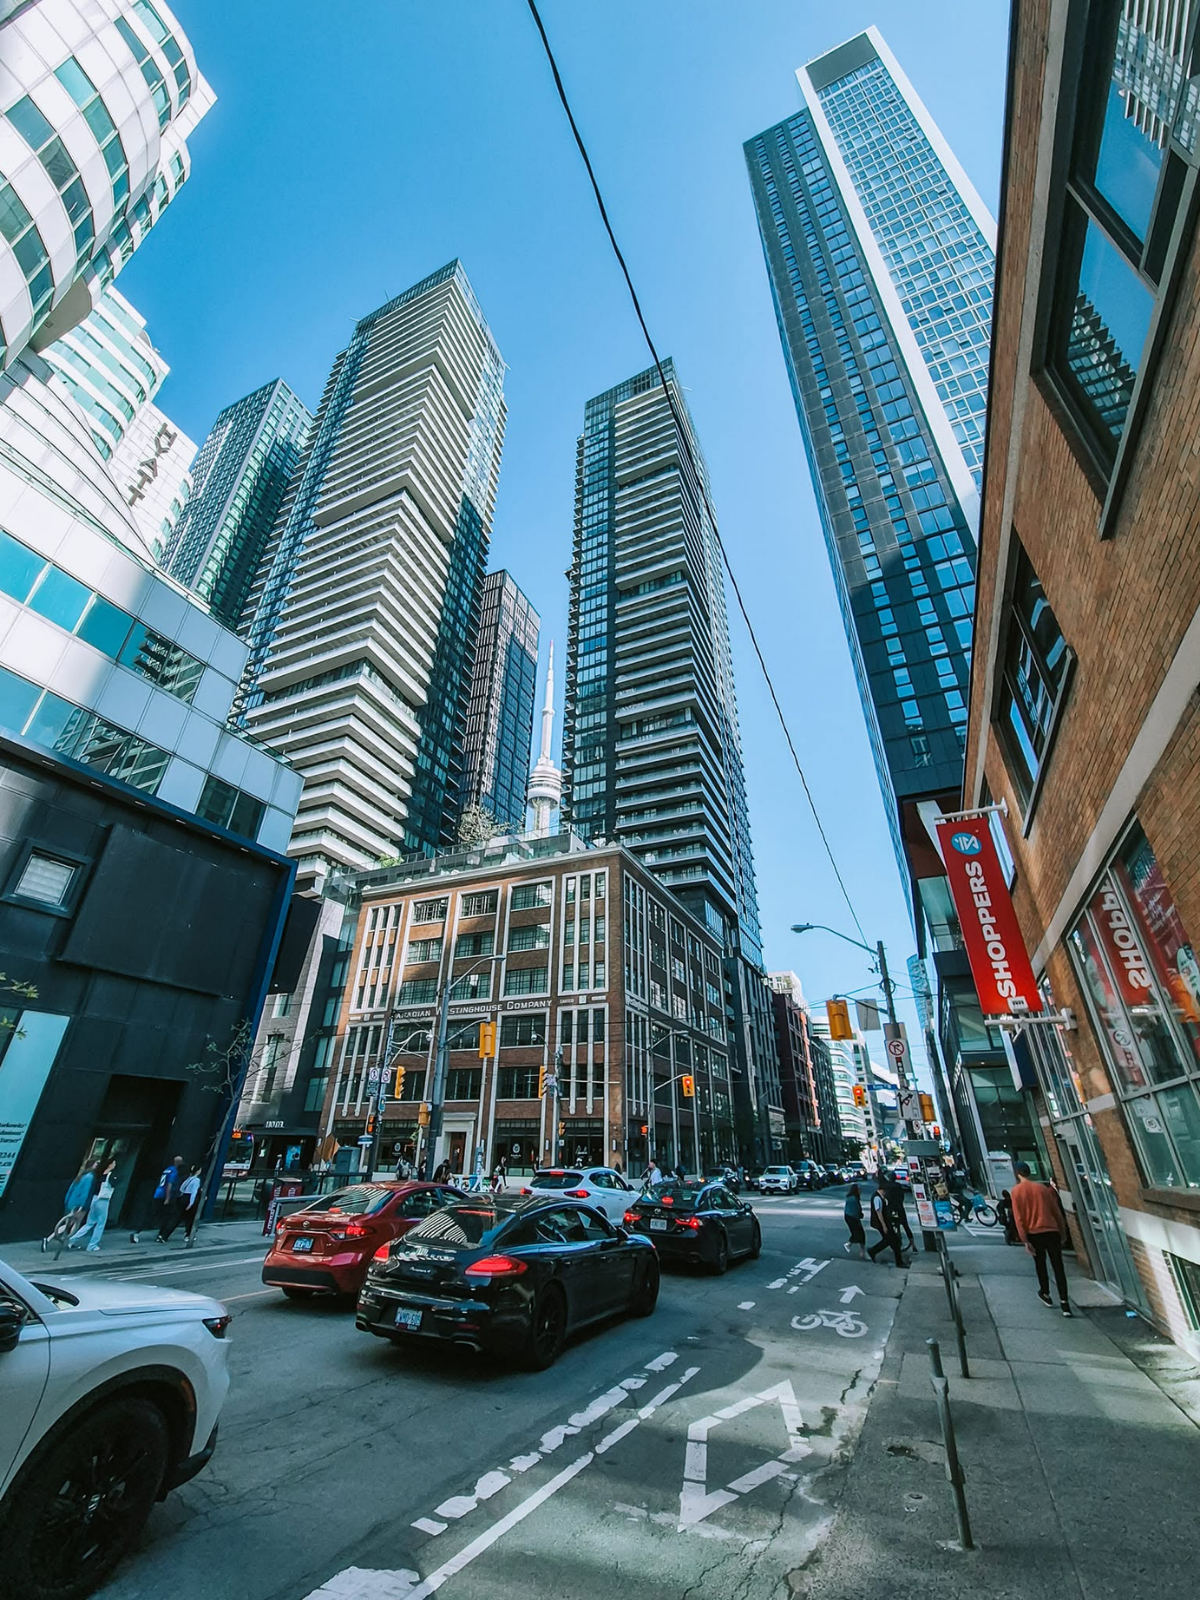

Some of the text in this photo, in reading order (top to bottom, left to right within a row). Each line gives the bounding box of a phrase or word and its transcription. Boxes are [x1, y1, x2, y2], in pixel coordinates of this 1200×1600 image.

[128, 422, 178, 507] HYATT
[965, 860, 1017, 998] SHOPPERS
[394, 1009, 431, 1020] AADIAN
[435, 1003, 503, 1016] WSTINGHOUSE
